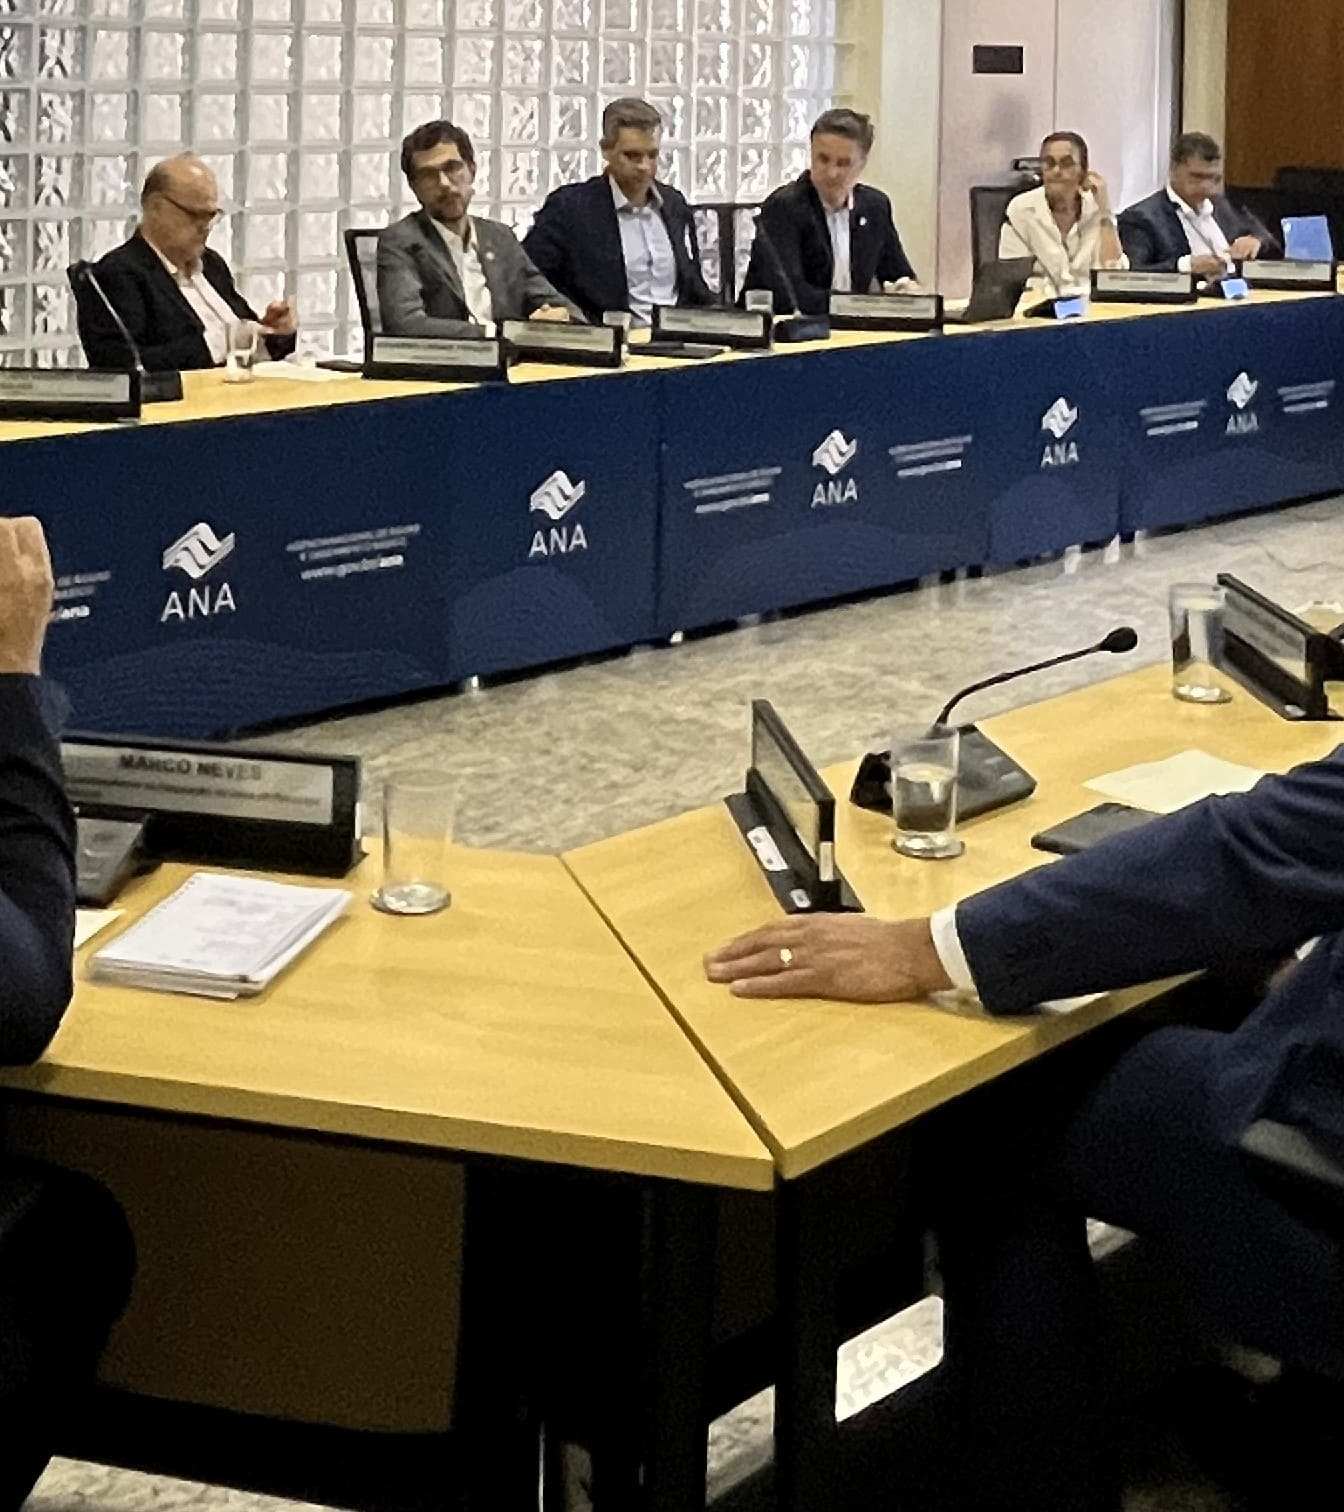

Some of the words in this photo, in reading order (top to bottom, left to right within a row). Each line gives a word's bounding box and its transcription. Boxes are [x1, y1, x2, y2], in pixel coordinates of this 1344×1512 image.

[1041, 440, 1080, 469] ANA
[810, 478, 860, 509] ANA
[529, 523, 588, 558] ANA
[160, 582, 237, 623] ANA
